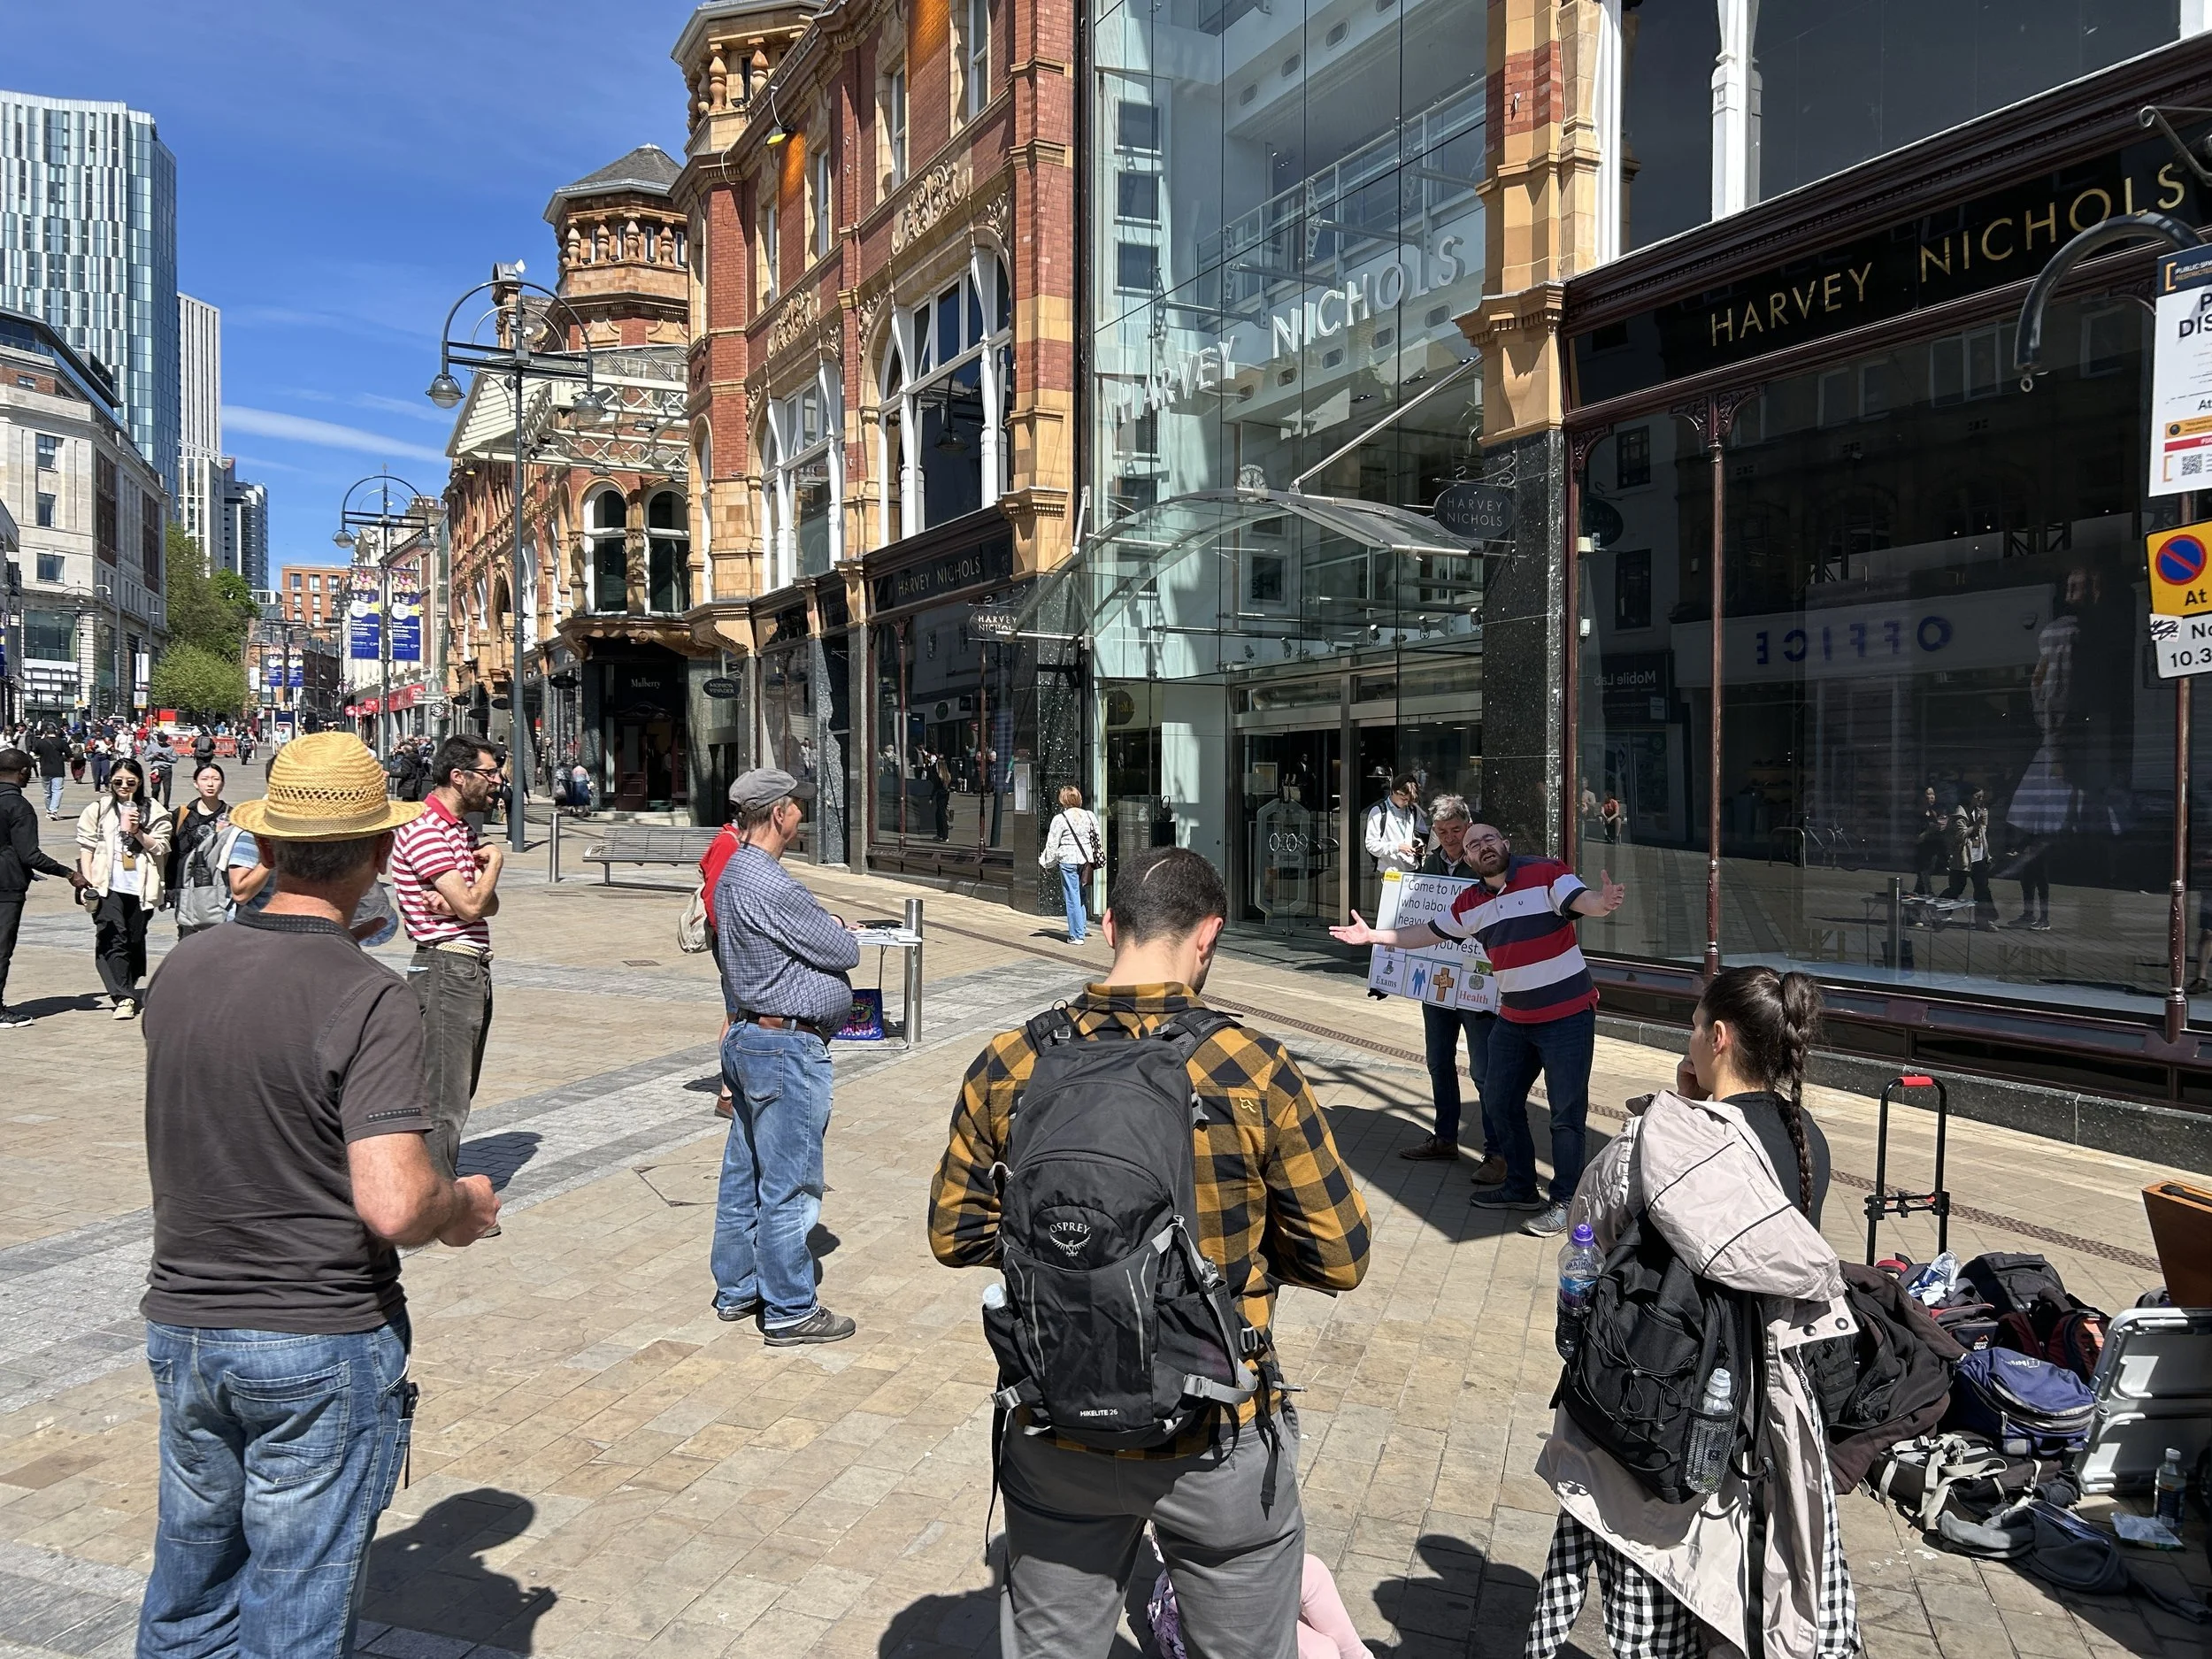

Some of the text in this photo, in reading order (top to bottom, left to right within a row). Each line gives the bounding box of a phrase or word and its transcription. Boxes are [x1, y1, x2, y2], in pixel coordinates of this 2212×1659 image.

[1710, 162, 2186, 347] HARVEY NICHOLS
[1114, 235, 1465, 425] HARVEY NICHOLS
[1447, 497, 1502, 511] HARVEY
[1447, 512, 1502, 526] NICHOLS
[898, 556, 982, 597] HARVEY NICHOLS
[2185, 588, 2208, 606] At
[978, 615, 1018, 624] HARVEY
[631, 677, 661, 689] Mulberry
[1437, 883, 1448, 895] to
[1401, 898, 1419, 910] who
[1375, 975, 1397, 988] Exams
[1460, 990, 1488, 1005] Health
[1049, 1222, 1091, 1235] OSPREY
